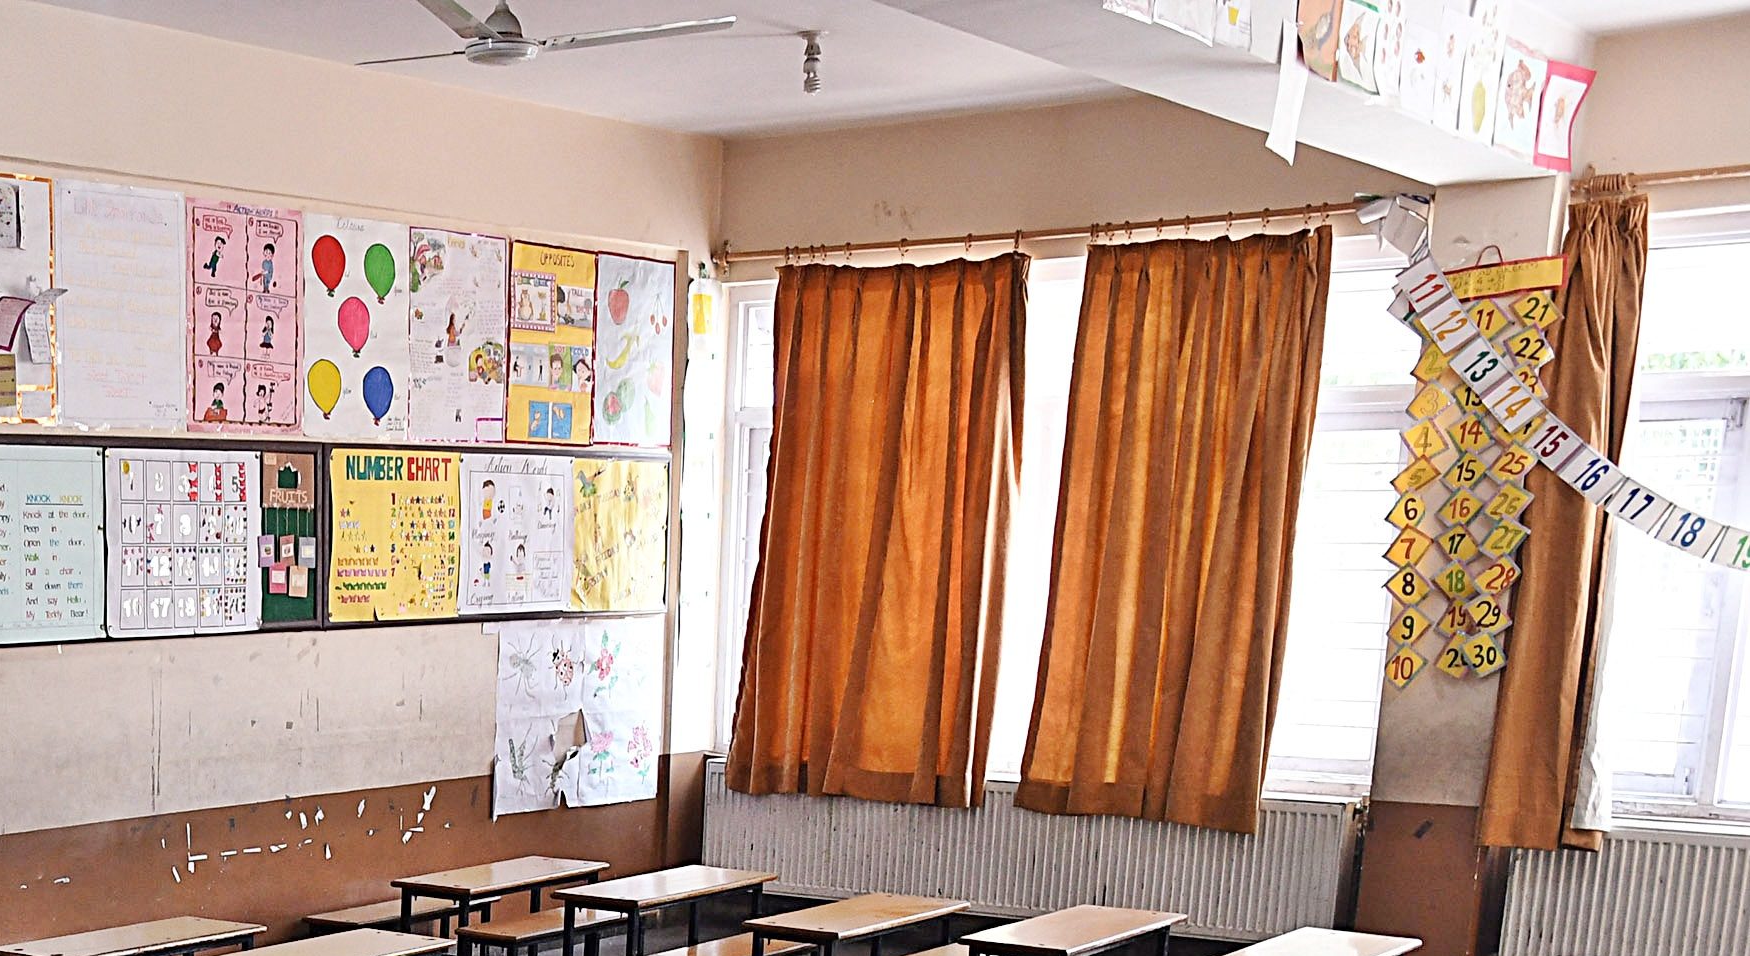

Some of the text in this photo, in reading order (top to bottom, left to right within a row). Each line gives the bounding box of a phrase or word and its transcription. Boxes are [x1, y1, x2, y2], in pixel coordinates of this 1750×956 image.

[540, 251, 575, 268] OPPOSITES
[1409, 273, 1444, 303] 11
[1474, 308, 1495, 332] 11
[1524, 296, 1547, 322] 21
[1432, 310, 1466, 341] 12
[1513, 338, 1545, 362] 22
[1461, 350, 1500, 383] 13
[1490, 385, 1531, 422] 14
[1459, 422, 1483, 445] 14
[1533, 425, 1568, 458] 15
[345, 456, 451, 482] NUMBER CHART
[1456, 460, 1476, 482] 15
[1498, 452, 1526, 476] 25
[1573, 458, 1609, 491] 16
[269, 489, 308, 503] FRUITS
[1450, 497, 1471, 519] 16
[1488, 493, 1518, 515] 26
[1618, 487, 1655, 520] 17
[1403, 497, 1418, 521] 6
[1671, 512, 1705, 548] 18
[1400, 538, 1415, 560] 7
[1448, 533, 1465, 554] 17
[1402, 572, 1415, 596] 8
[1446, 569, 1465, 593] 18
[1485, 563, 1516, 591] 28
[1476, 600, 1501, 627] 29
[1401, 616, 1415, 640] 9
[1472, 644, 1497, 666] 30
[1390, 655, 1414, 681] 10
